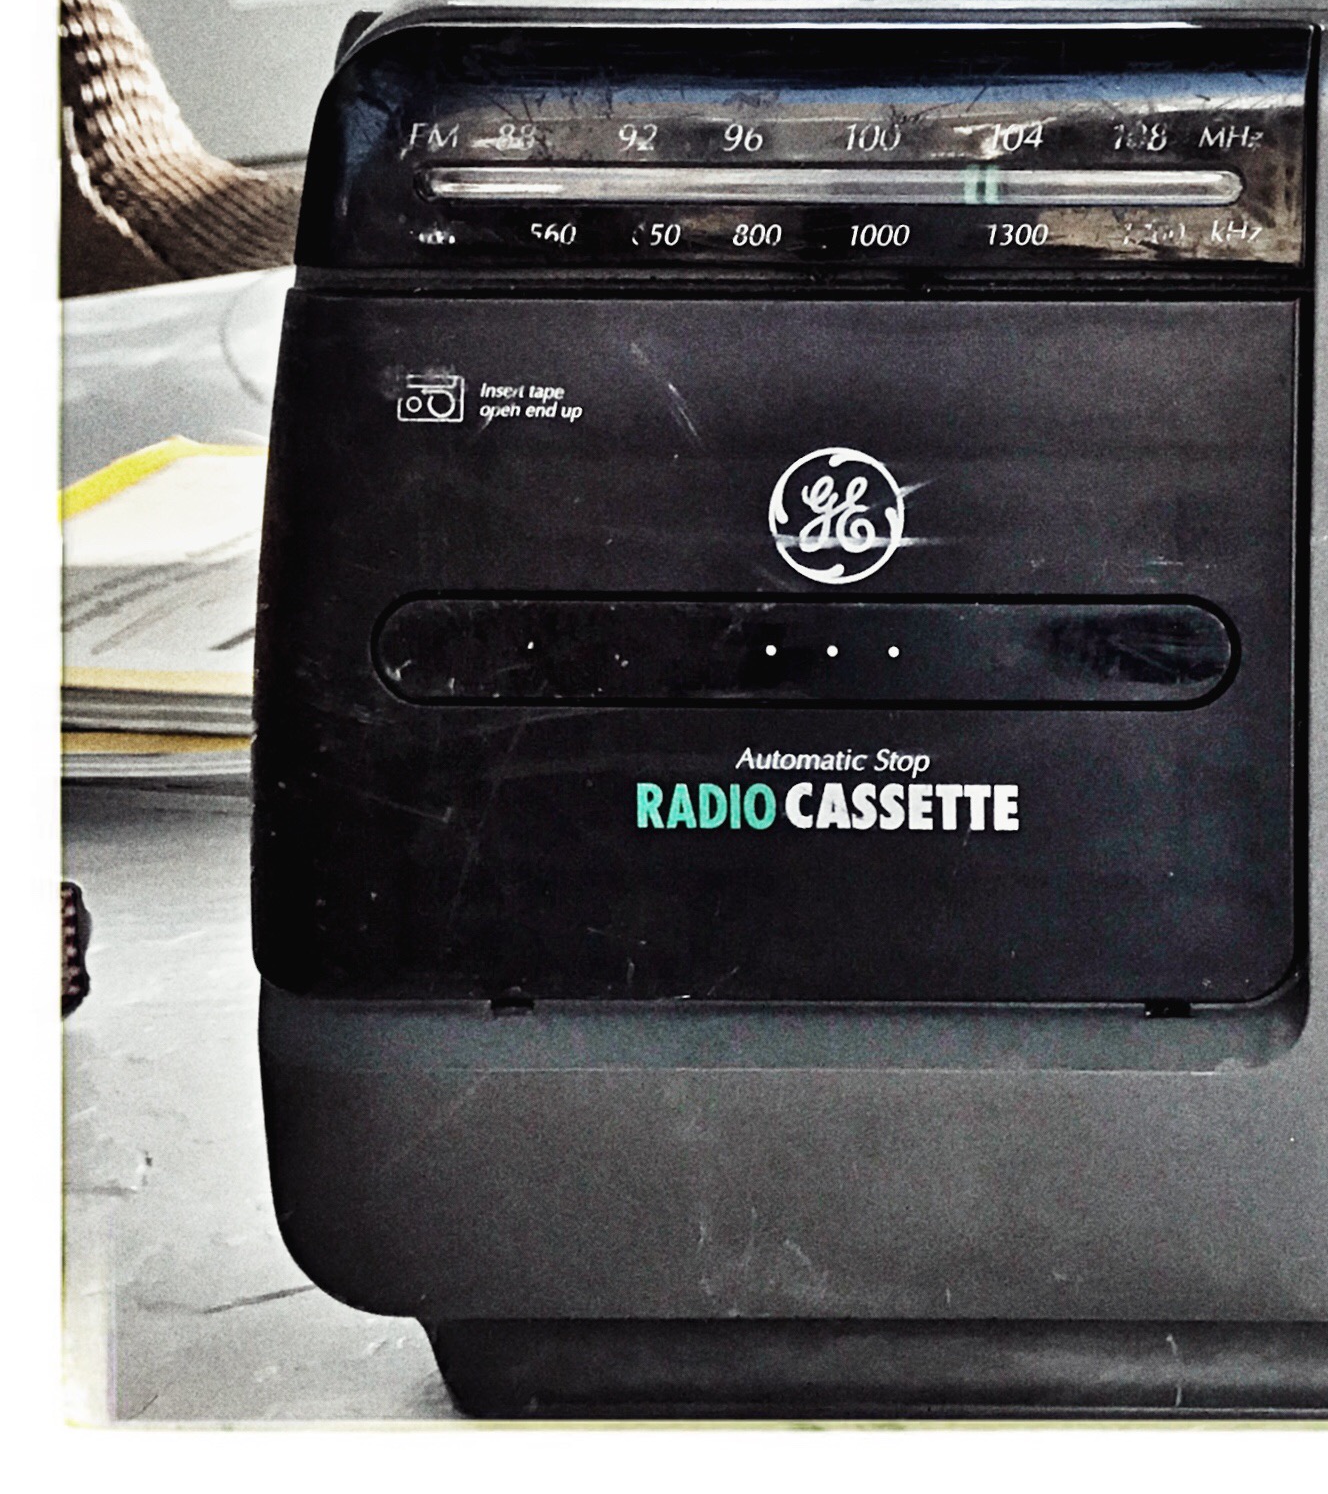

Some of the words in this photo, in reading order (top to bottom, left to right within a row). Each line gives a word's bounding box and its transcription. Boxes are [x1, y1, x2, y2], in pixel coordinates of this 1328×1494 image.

[409, 122, 460, 148] FM
[495, 122, 537, 151] 88
[618, 123, 658, 152] 92
[723, 123, 764, 152] 96
[846, 123, 901, 152] 100
[991, 122, 1044, 152] 104
[1198, 124, 1264, 151] MHz
[530, 222, 577, 246] 560
[732, 223, 782, 247] 800
[849, 224, 910, 247] 1000
[986, 223, 1049, 247] 1300
[480, 382, 524, 399] Insert
[529, 385, 565, 404] tape
[479, 403, 521, 421] open
[525, 402, 557, 418] end
[561, 406, 583, 423] up
[735, 746, 867, 772] Automatic
[873, 747, 930, 778] Stop
[636, 782, 777, 830] RADIO
[785, 782, 1020, 832] CASSETTE
